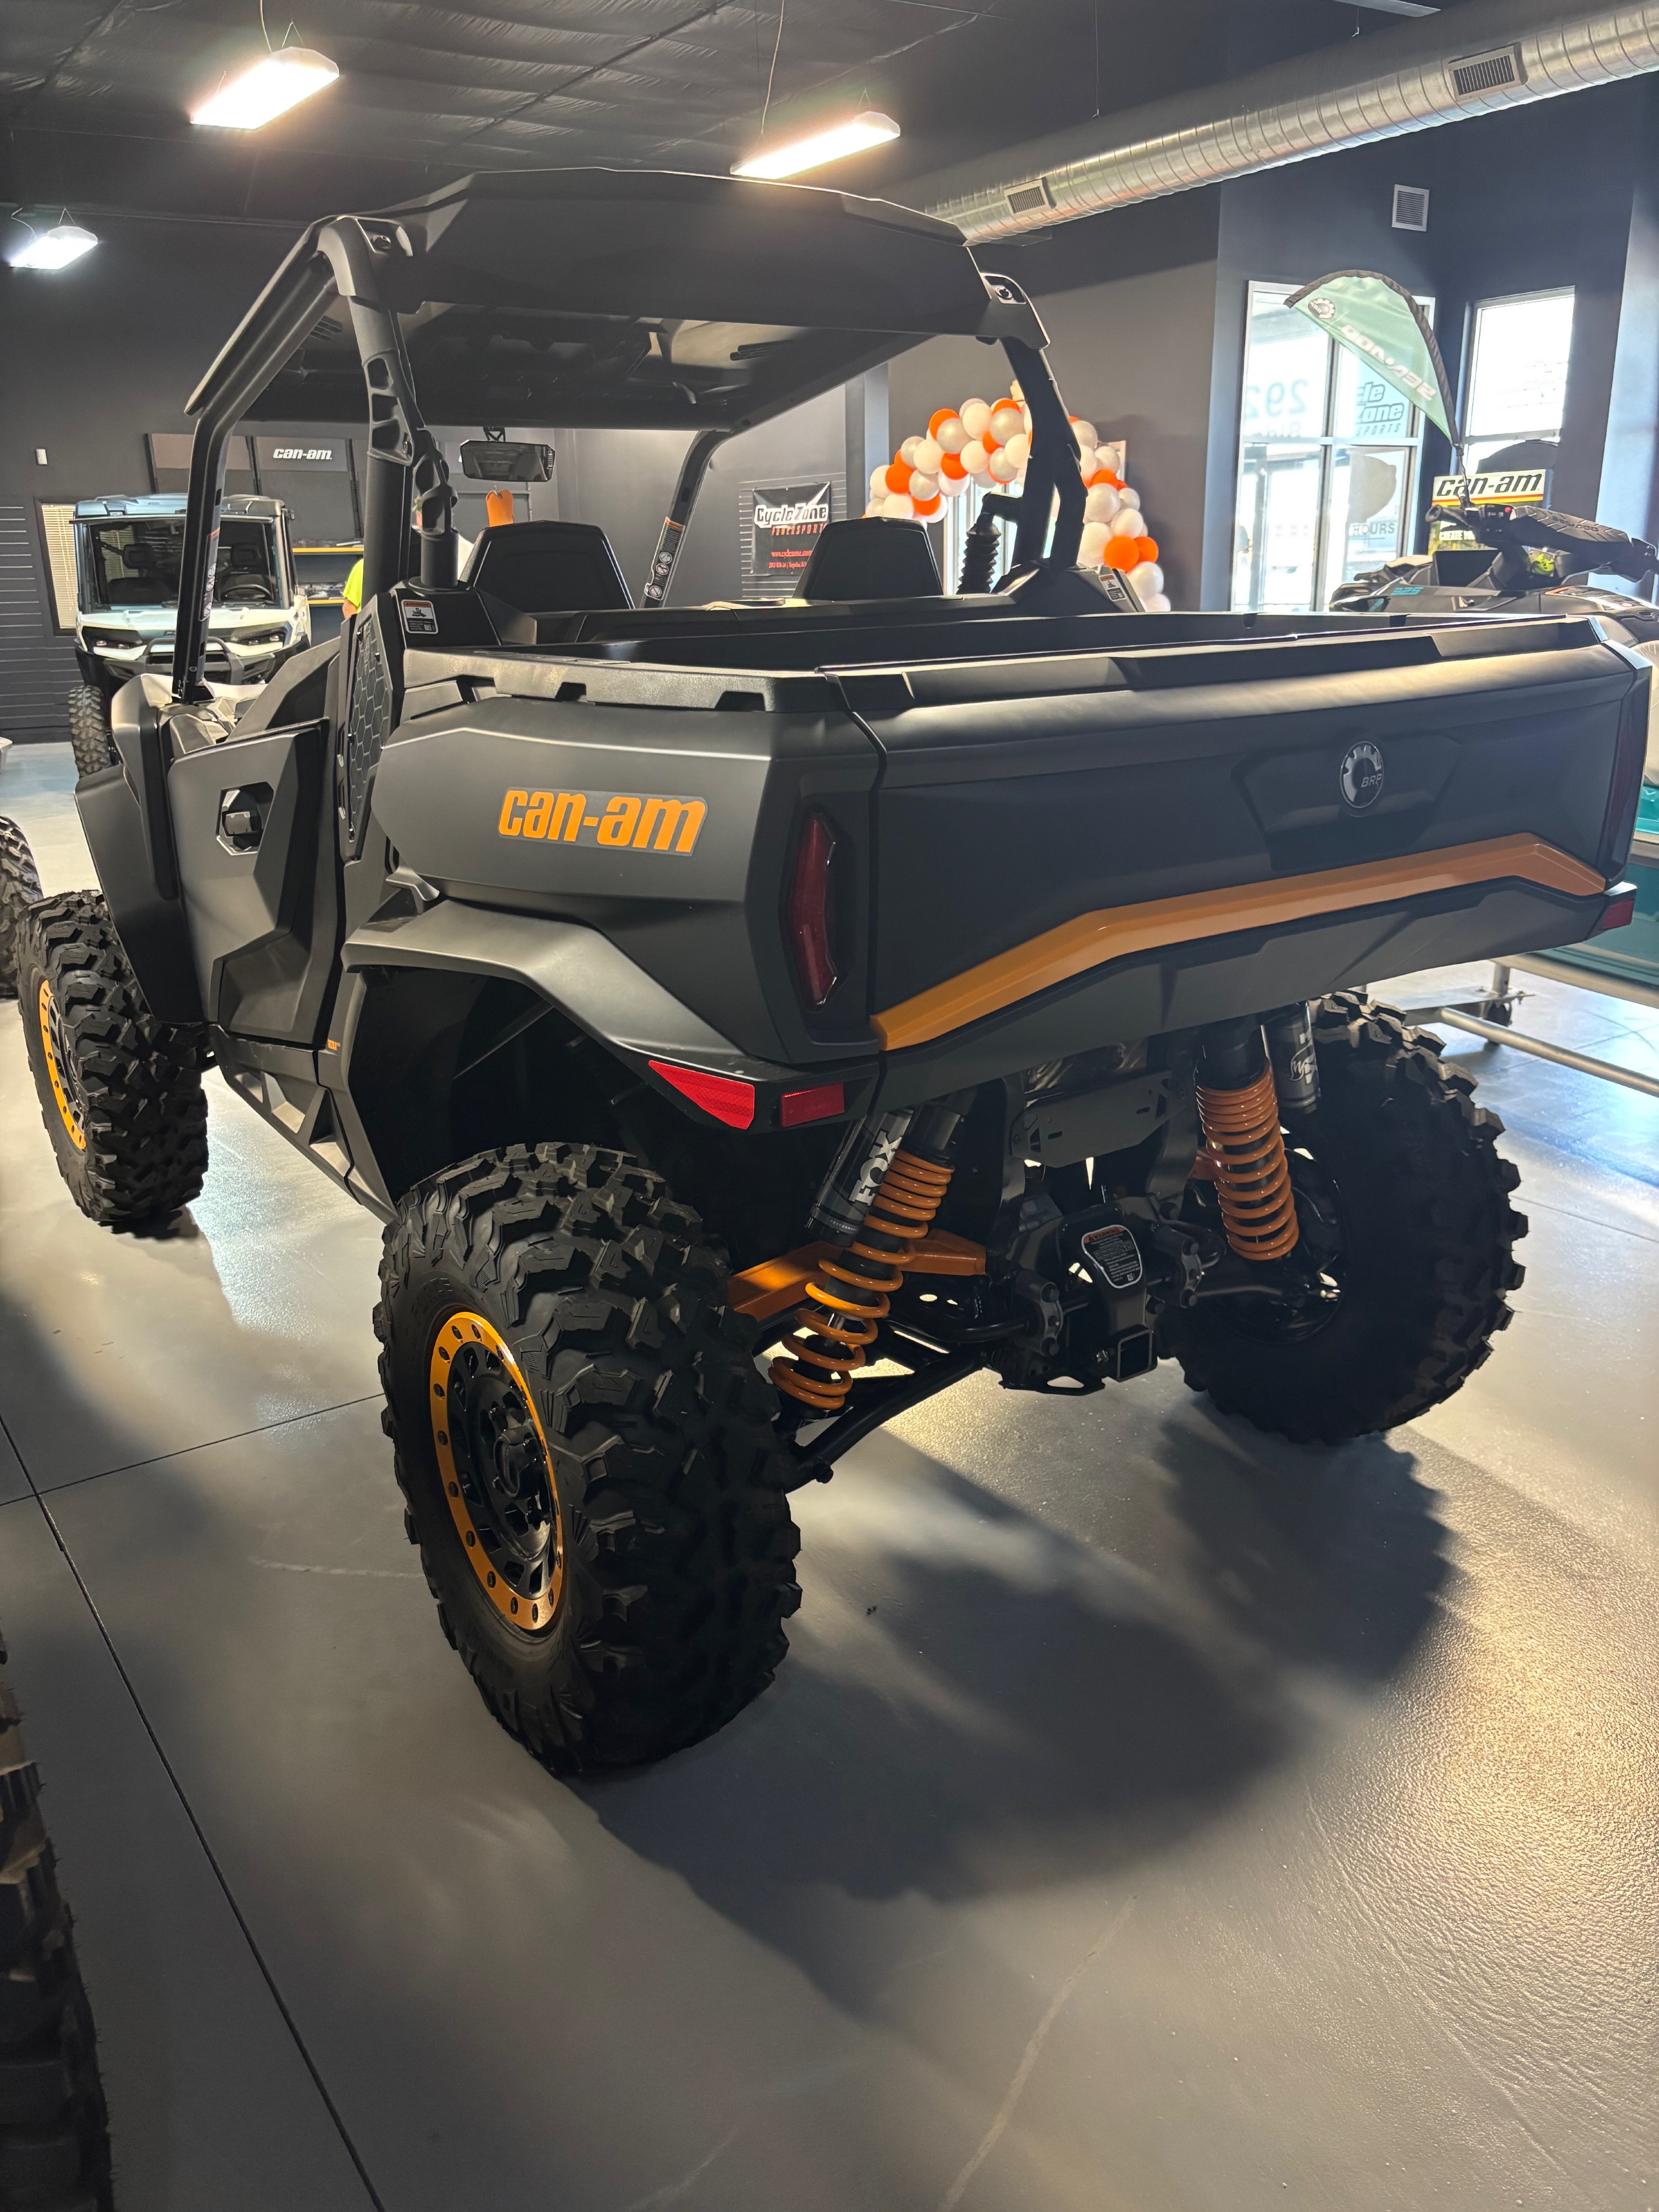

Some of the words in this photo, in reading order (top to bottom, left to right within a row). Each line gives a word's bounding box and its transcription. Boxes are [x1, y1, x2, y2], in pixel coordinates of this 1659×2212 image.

[273, 449, 332, 460] can-am
[1437, 474, 1542, 496] can-am
[1353, 523, 1395, 536] HOURS
[1361, 774, 1382, 788] BRP
[499, 790, 706, 852] can-am
[848, 1130, 902, 1206] FOX
[1094, 1228, 1120, 1240] WARNING
